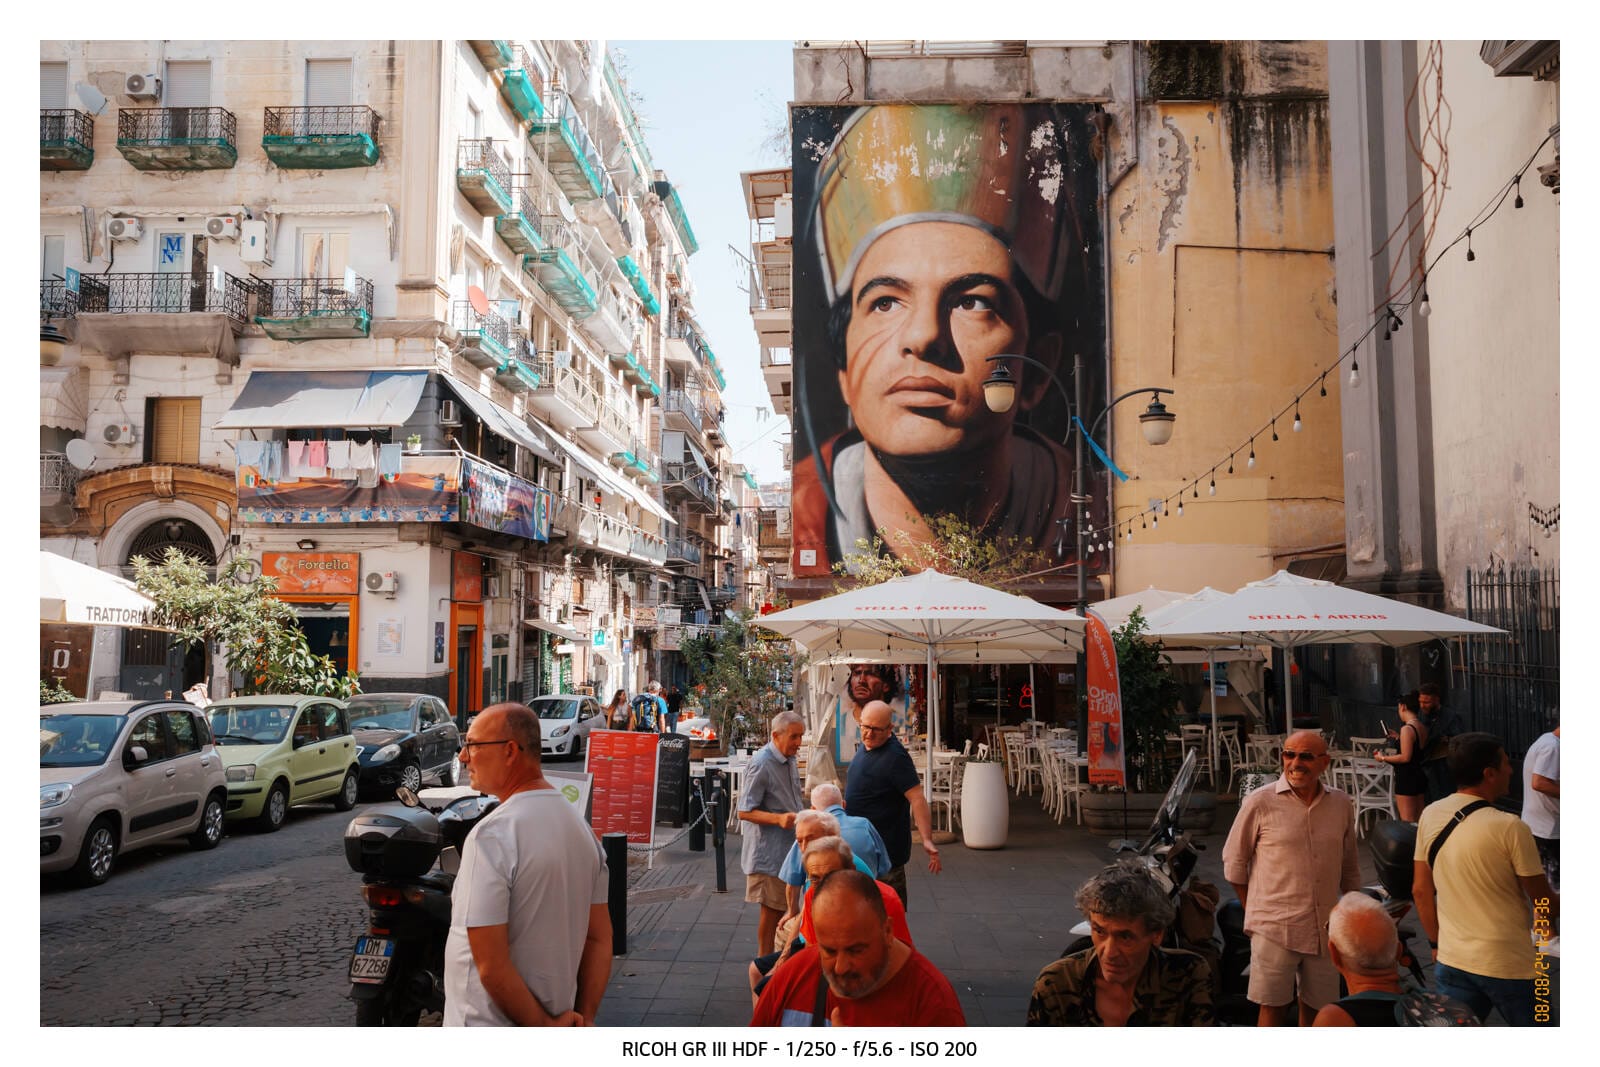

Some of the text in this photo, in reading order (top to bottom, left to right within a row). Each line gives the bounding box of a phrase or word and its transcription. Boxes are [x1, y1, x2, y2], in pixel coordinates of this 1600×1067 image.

[298, 559, 350, 570] Forcella
[86, 606, 148, 624] TRATTORIA
[365, 938, 381, 955] DM
[352, 958, 389, 975] 67268
